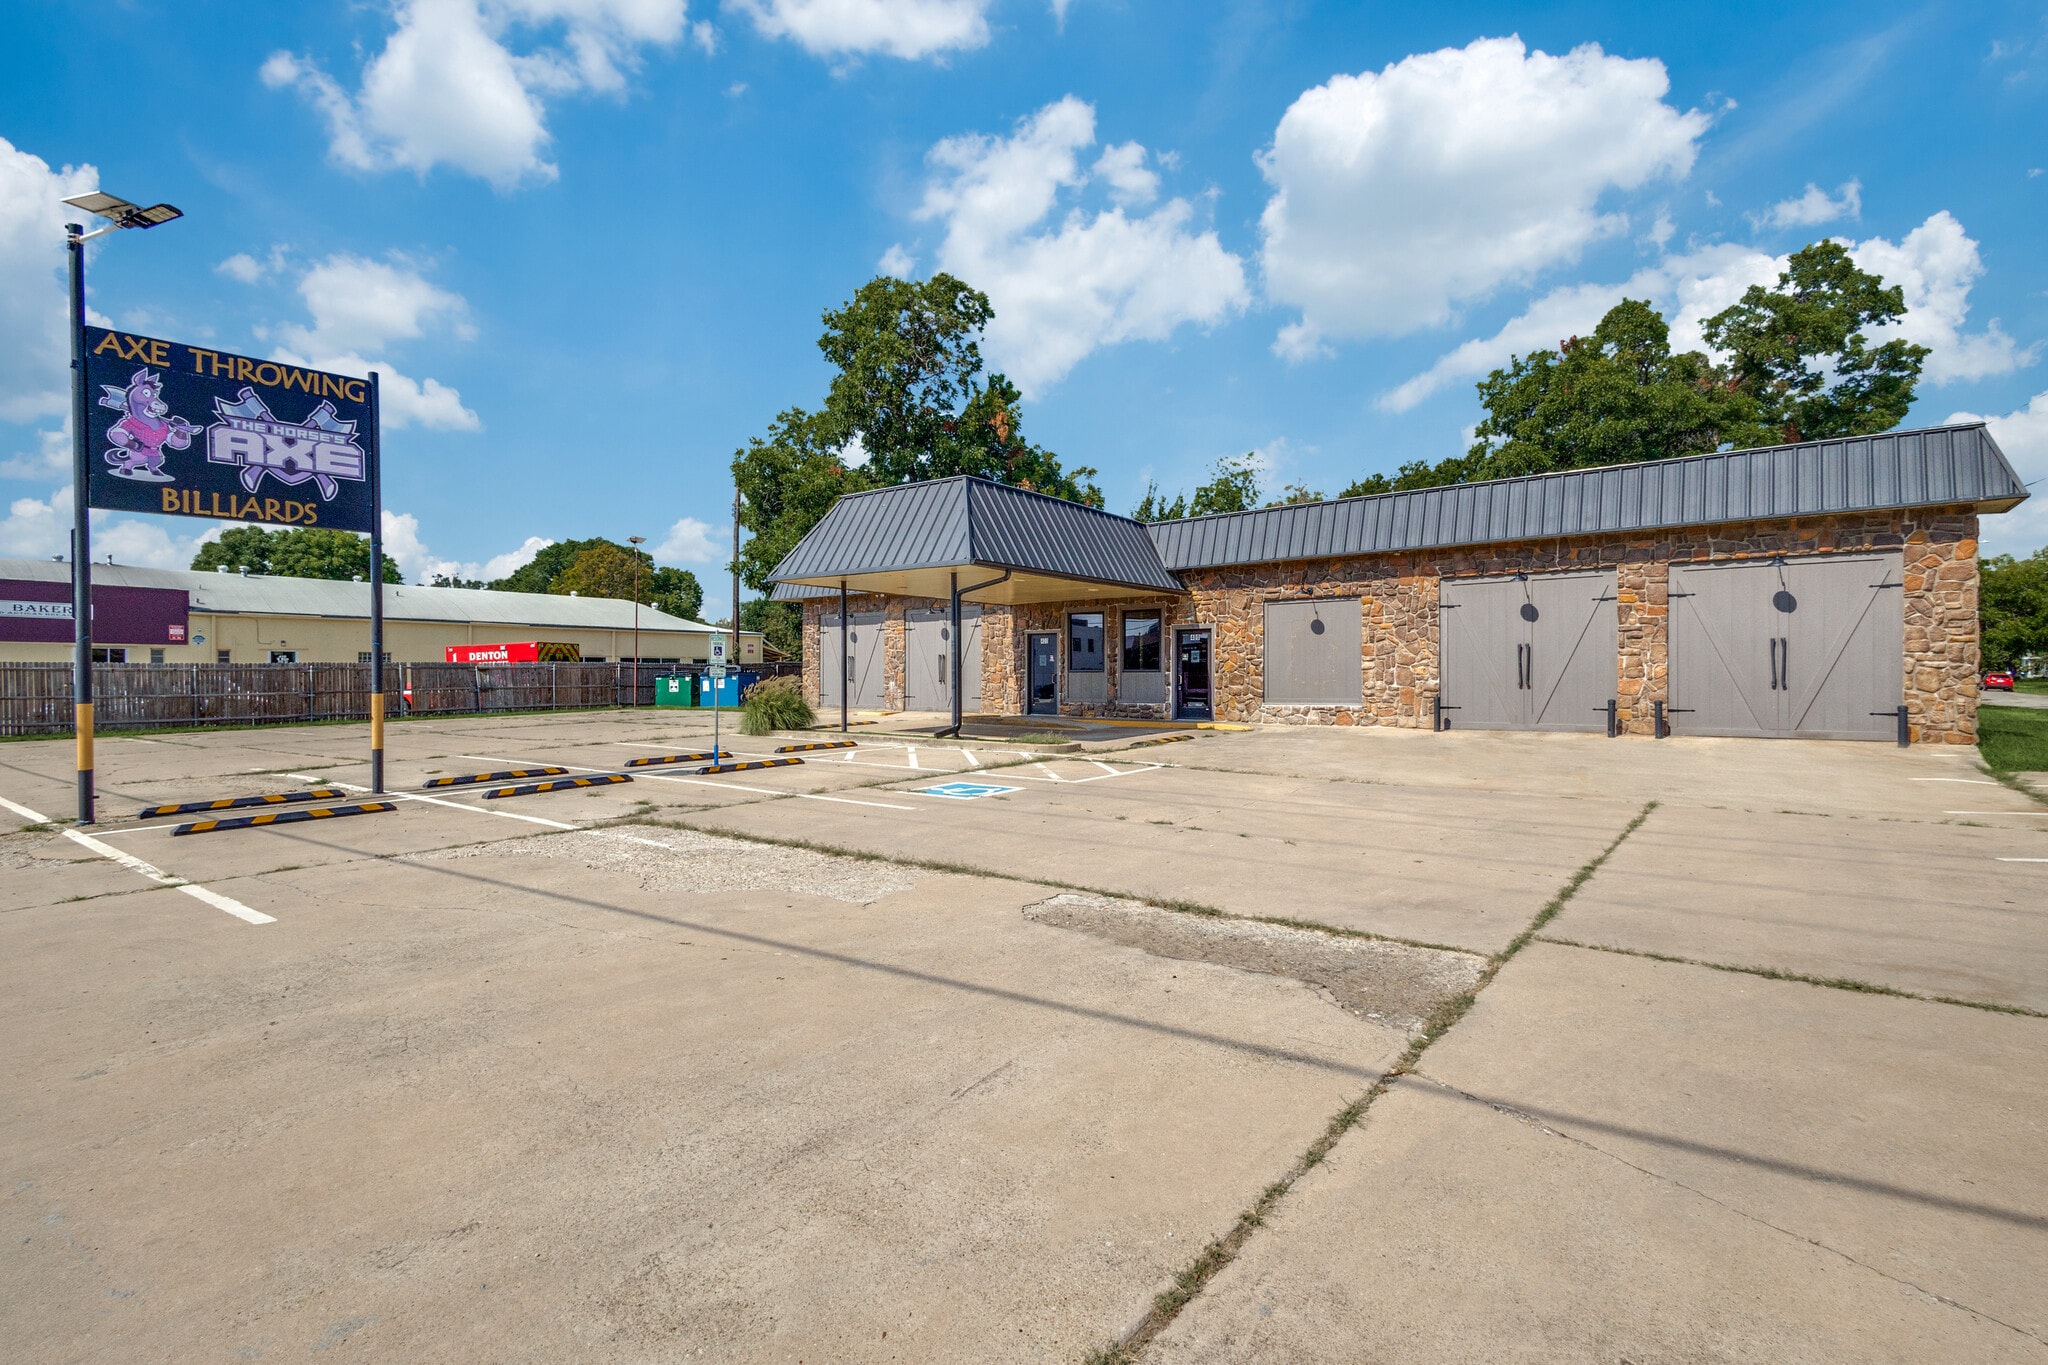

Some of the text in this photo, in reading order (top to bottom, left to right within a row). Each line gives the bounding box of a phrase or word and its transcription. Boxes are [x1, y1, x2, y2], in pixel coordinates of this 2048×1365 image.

[94, 332, 365, 403] AXE THROWING
[230, 418, 347, 445] THE HORSE'S
[213, 427, 361, 477] AXE
[162, 487, 318, 525] BILLIARDS
[13, 604, 73, 614] BAKER
[469, 651, 508, 660] DENTON
